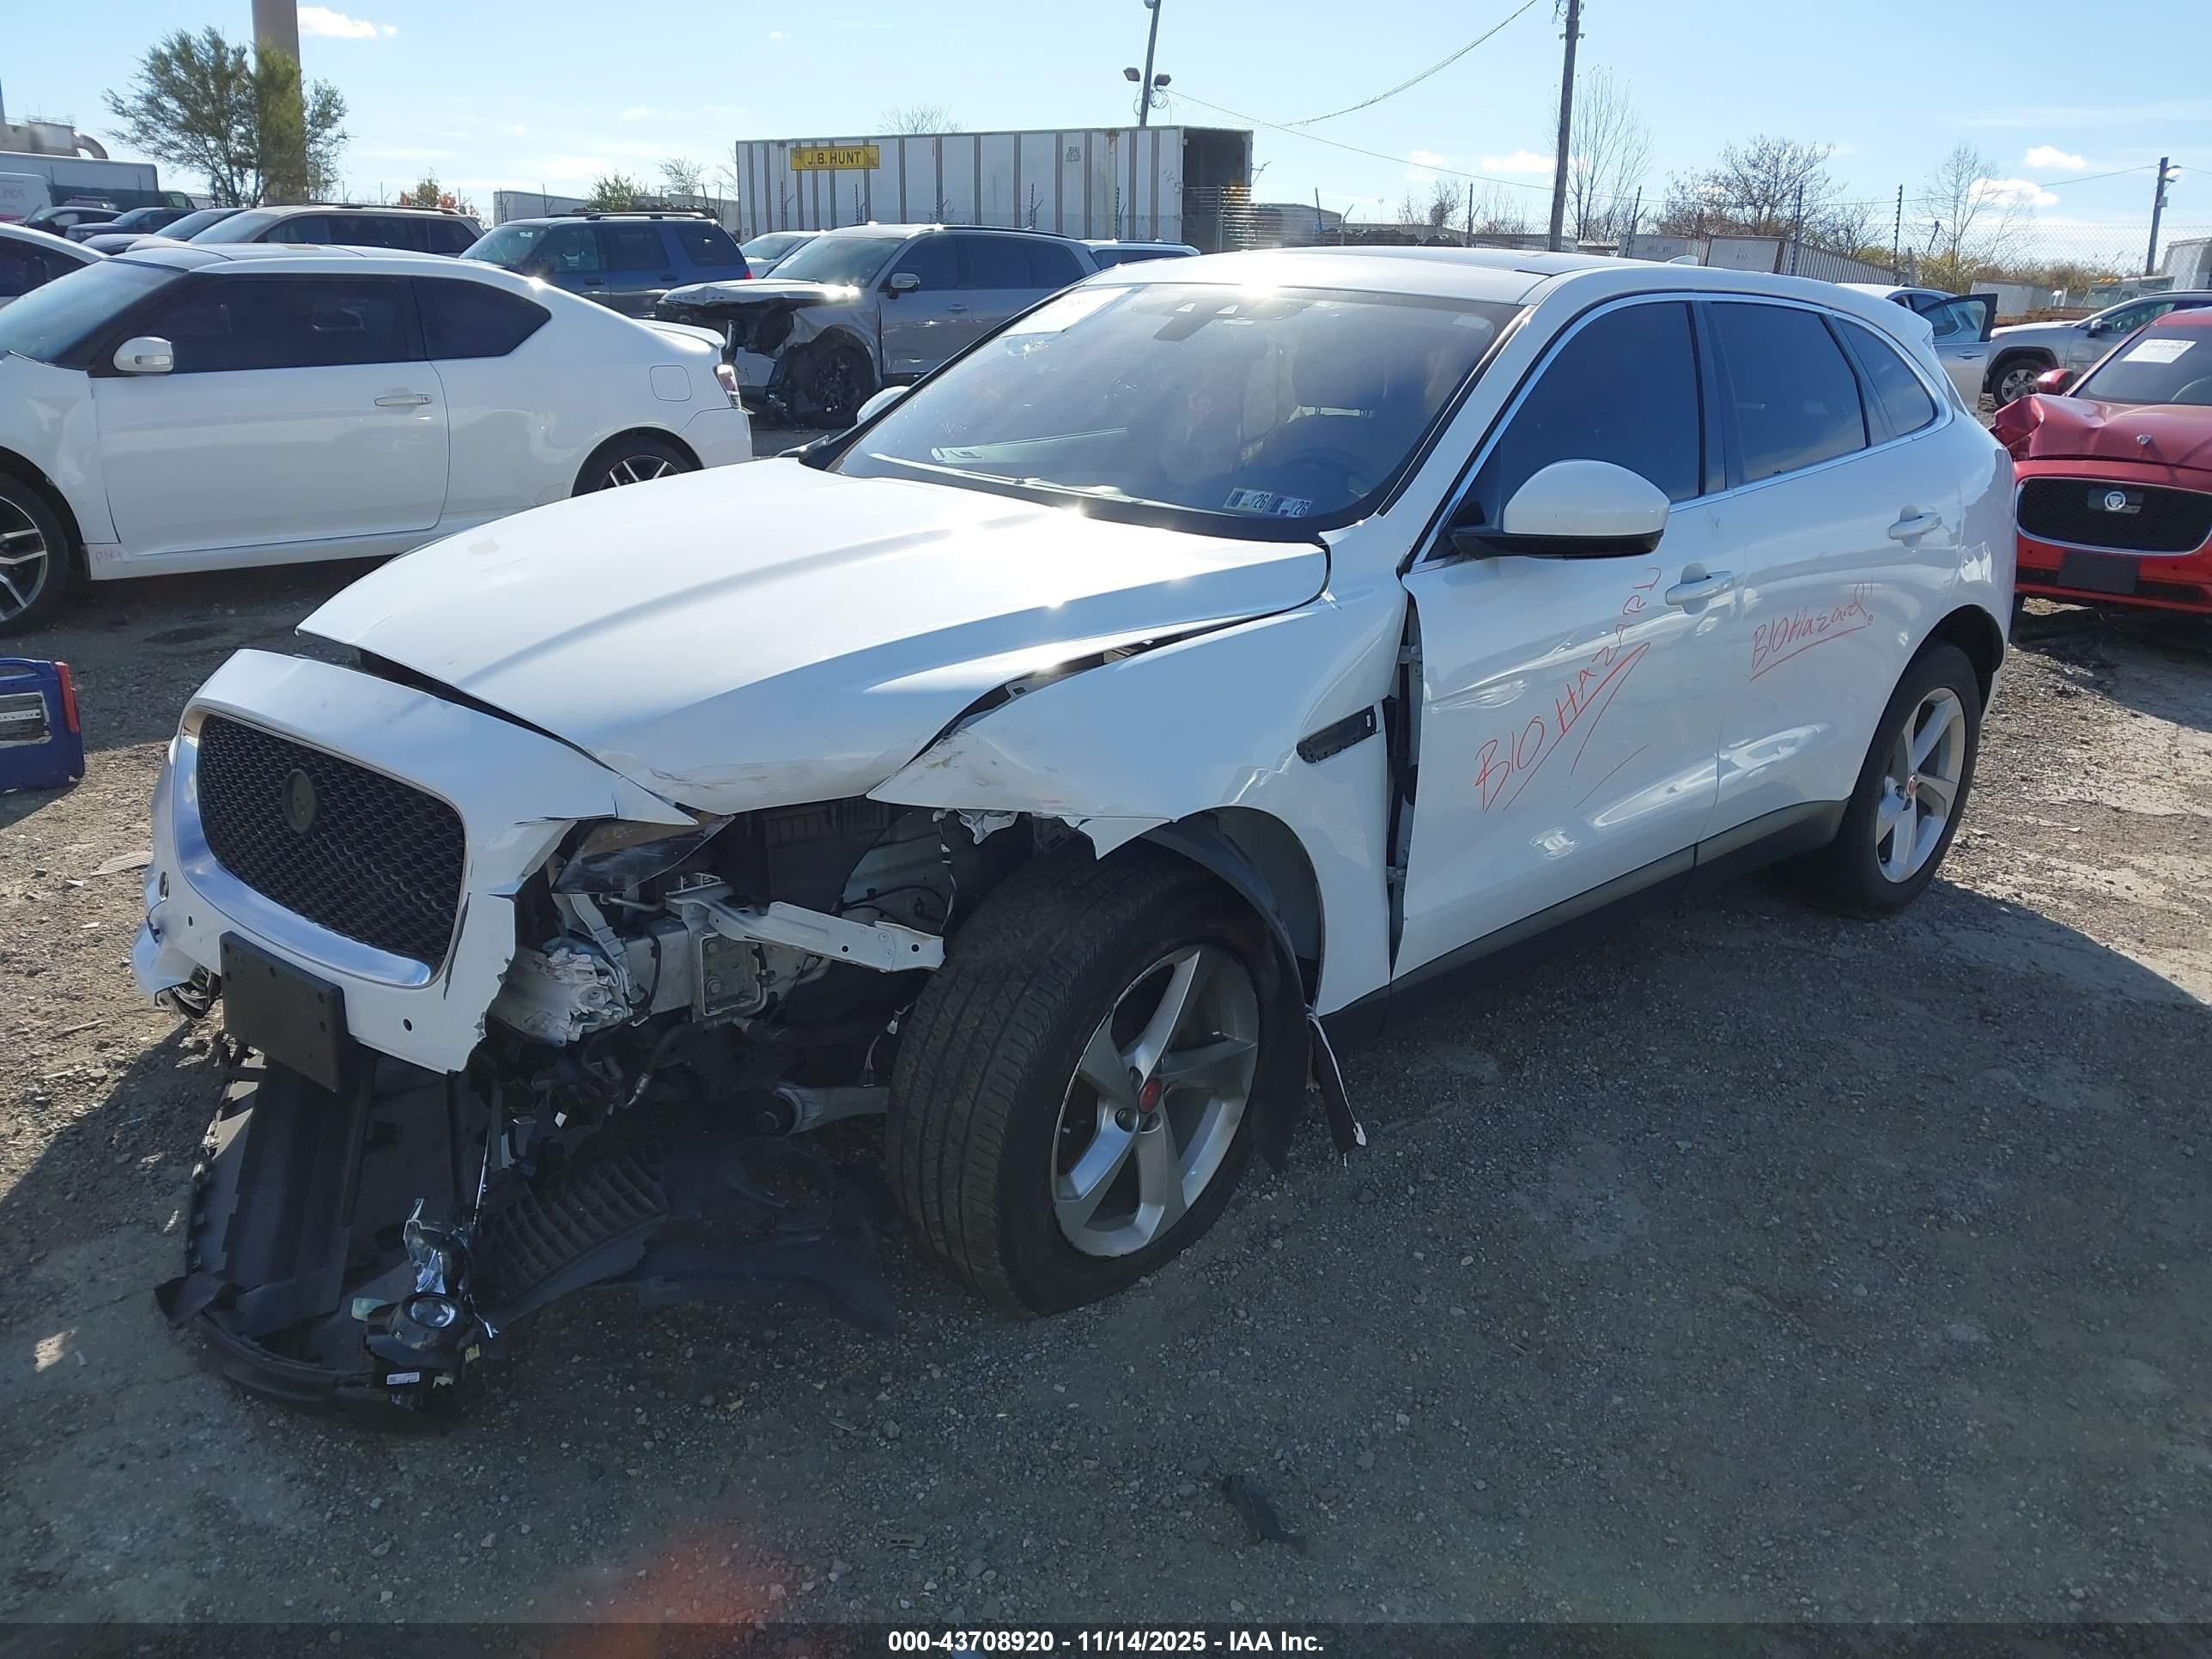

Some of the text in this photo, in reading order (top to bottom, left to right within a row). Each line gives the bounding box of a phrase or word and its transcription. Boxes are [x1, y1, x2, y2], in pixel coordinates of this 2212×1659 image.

[830, 150, 861, 165] HUNT
[1253, 493, 1268, 509] 26
[1293, 500, 1310, 516] 26
